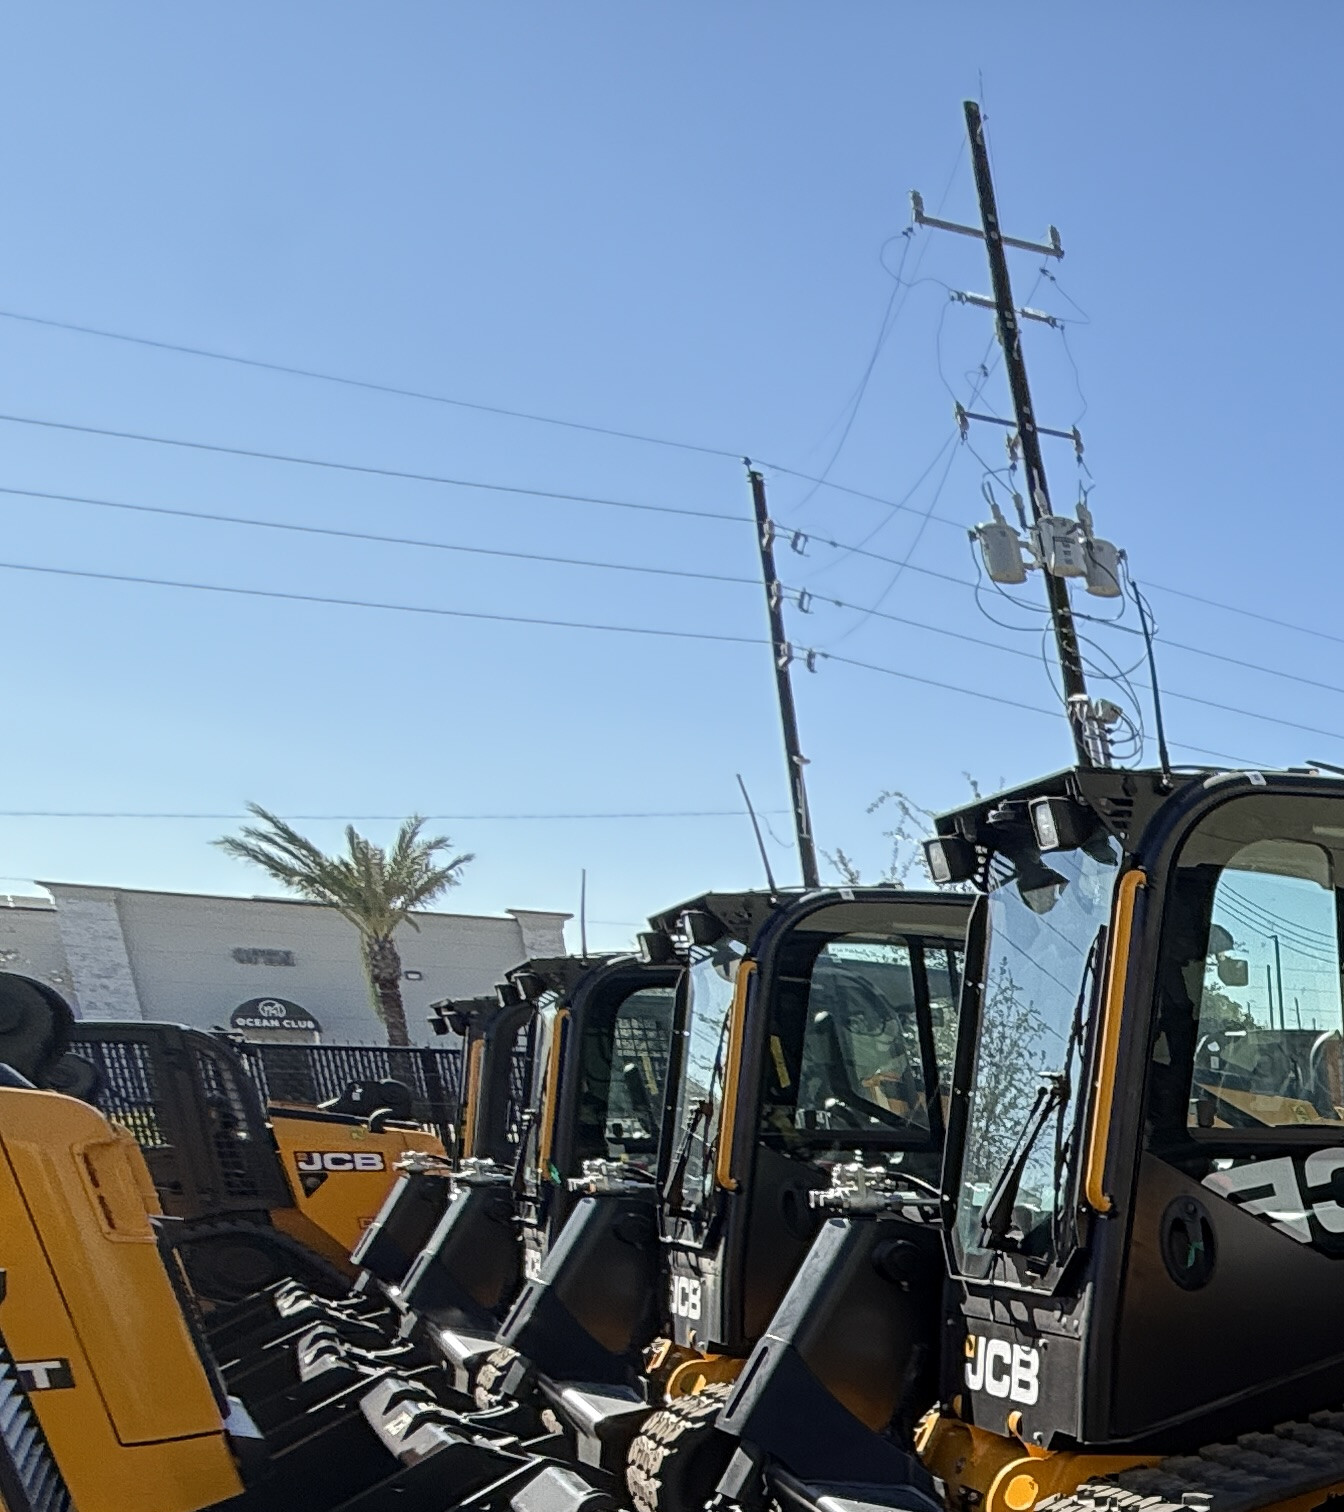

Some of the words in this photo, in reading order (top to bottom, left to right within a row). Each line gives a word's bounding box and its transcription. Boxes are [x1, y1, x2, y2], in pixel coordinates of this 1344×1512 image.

[236, 1017, 280, 1027] OCEAN
[282, 1019, 315, 1029] CLUB
[298, 1153, 385, 1171] JCB
[965, 1336, 1040, 1405] JCB
